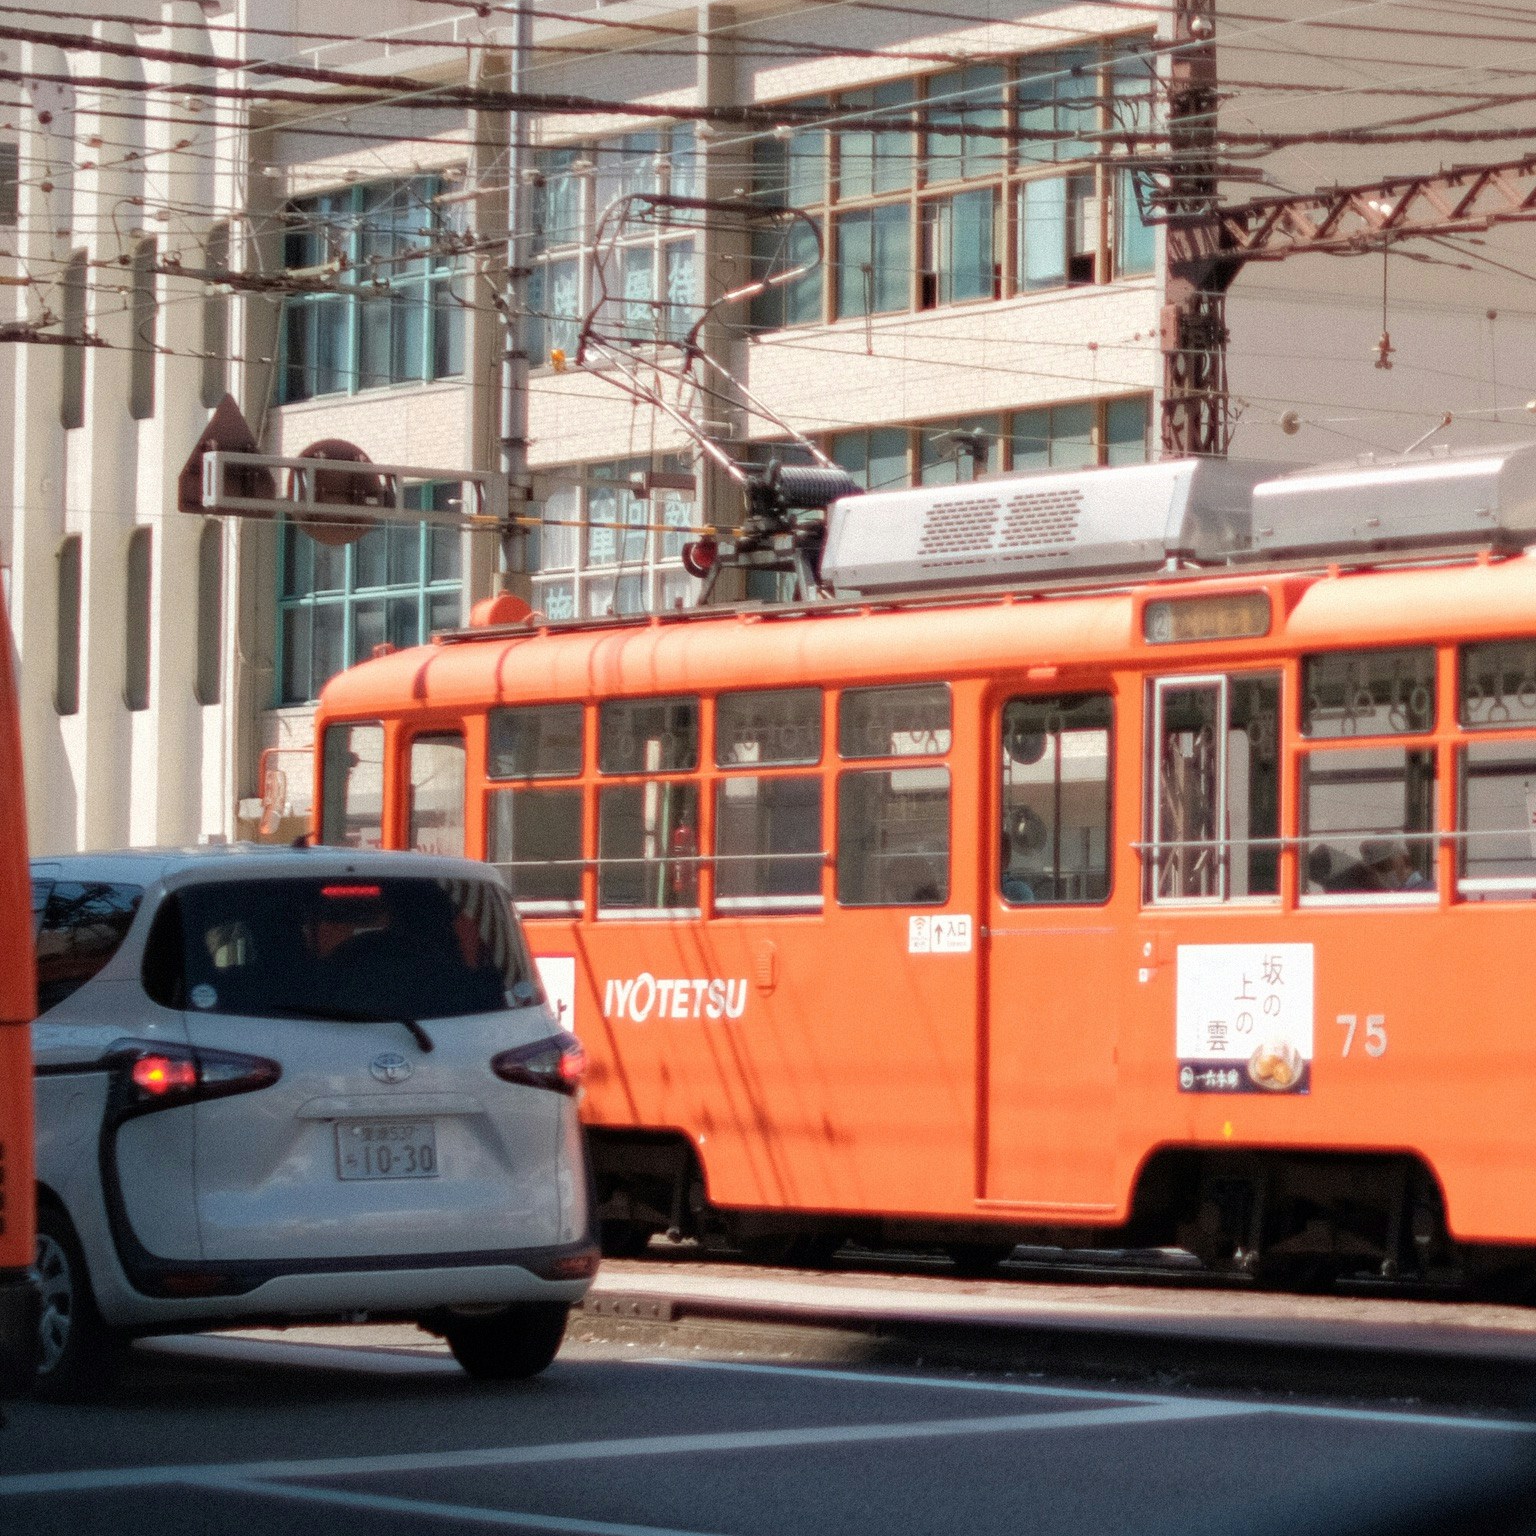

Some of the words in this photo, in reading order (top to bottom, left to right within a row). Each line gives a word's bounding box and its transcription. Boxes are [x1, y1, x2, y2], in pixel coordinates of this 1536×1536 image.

[946, 921, 967, 937] 入口
[603, 972, 748, 1023] IYOTETSU
[1234, 972, 1258, 1035] 上の
[1261, 953, 1285, 1017] 坂の
[1206, 1019, 1230, 1052] 雲
[1335, 1013, 1388, 1058] 75
